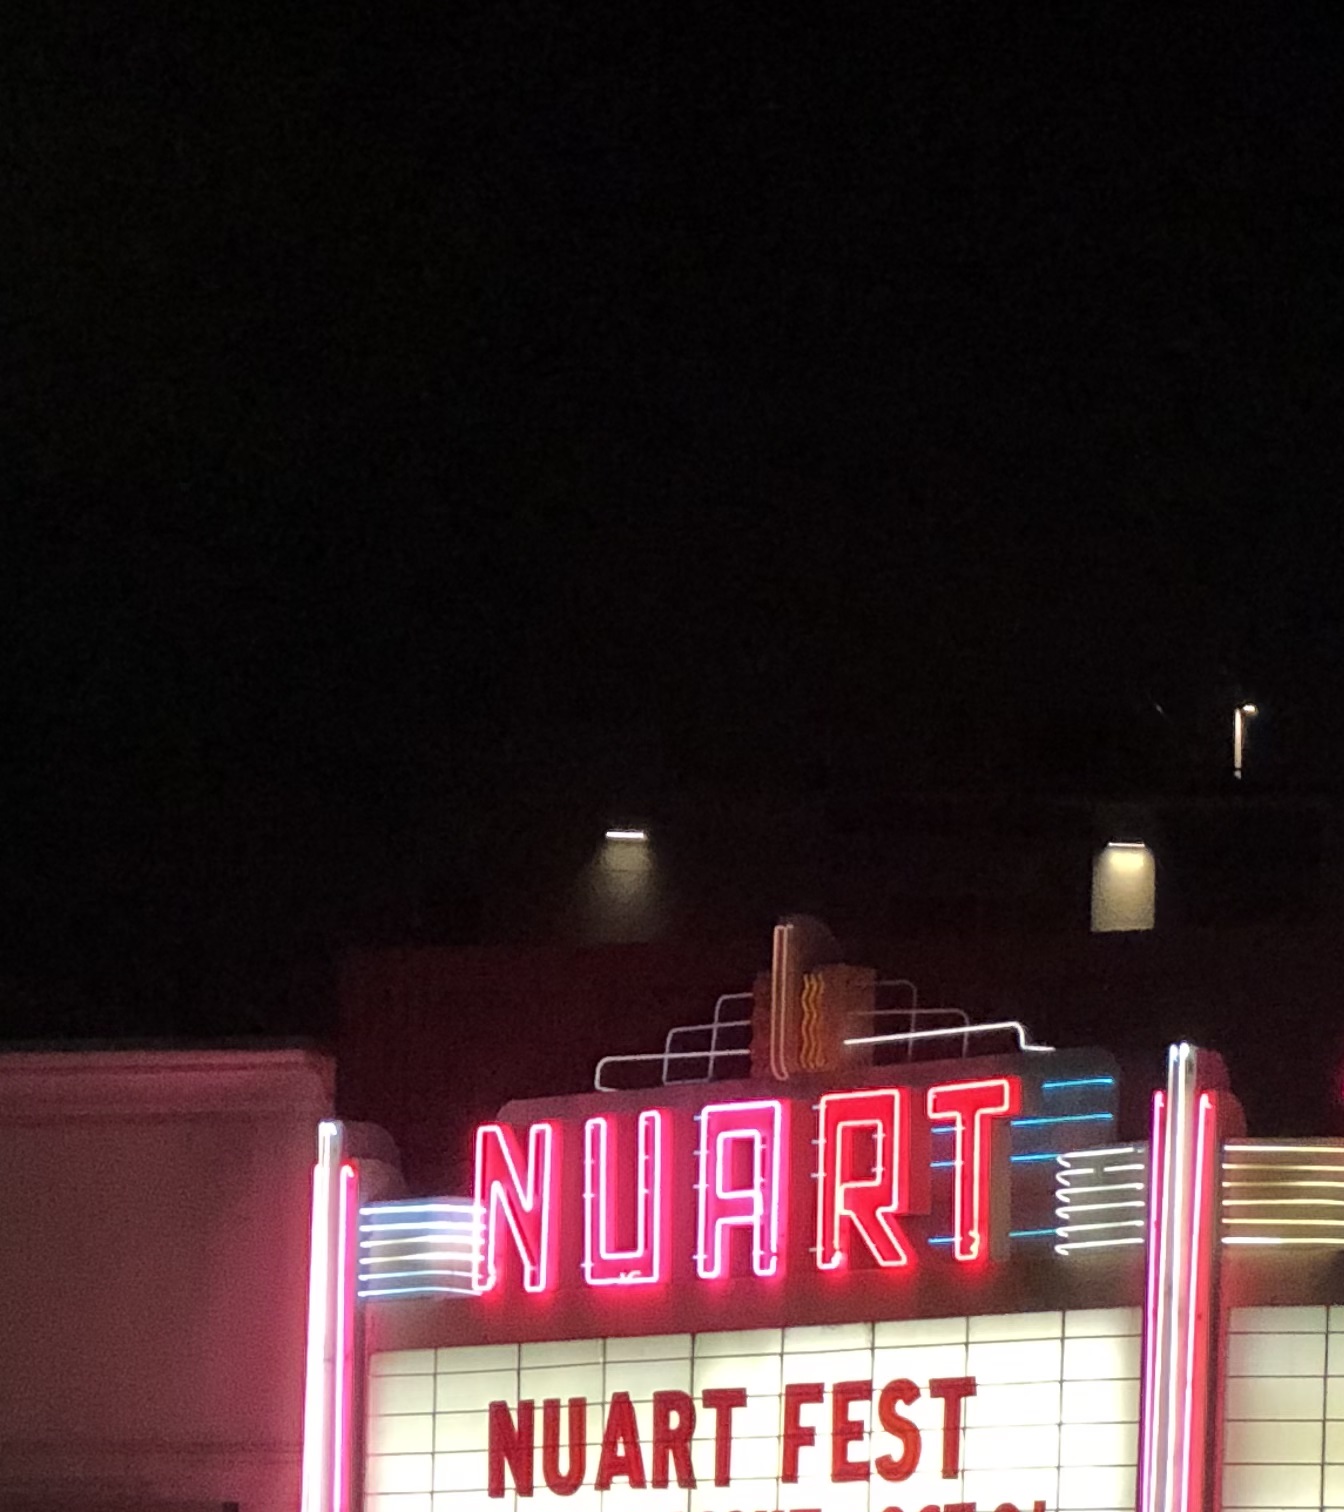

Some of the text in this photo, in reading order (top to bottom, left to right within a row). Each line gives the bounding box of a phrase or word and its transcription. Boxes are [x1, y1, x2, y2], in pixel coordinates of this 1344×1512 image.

[470, 1077, 1022, 1293] NUART
[486, 1376, 978, 1499] NUART FEST
